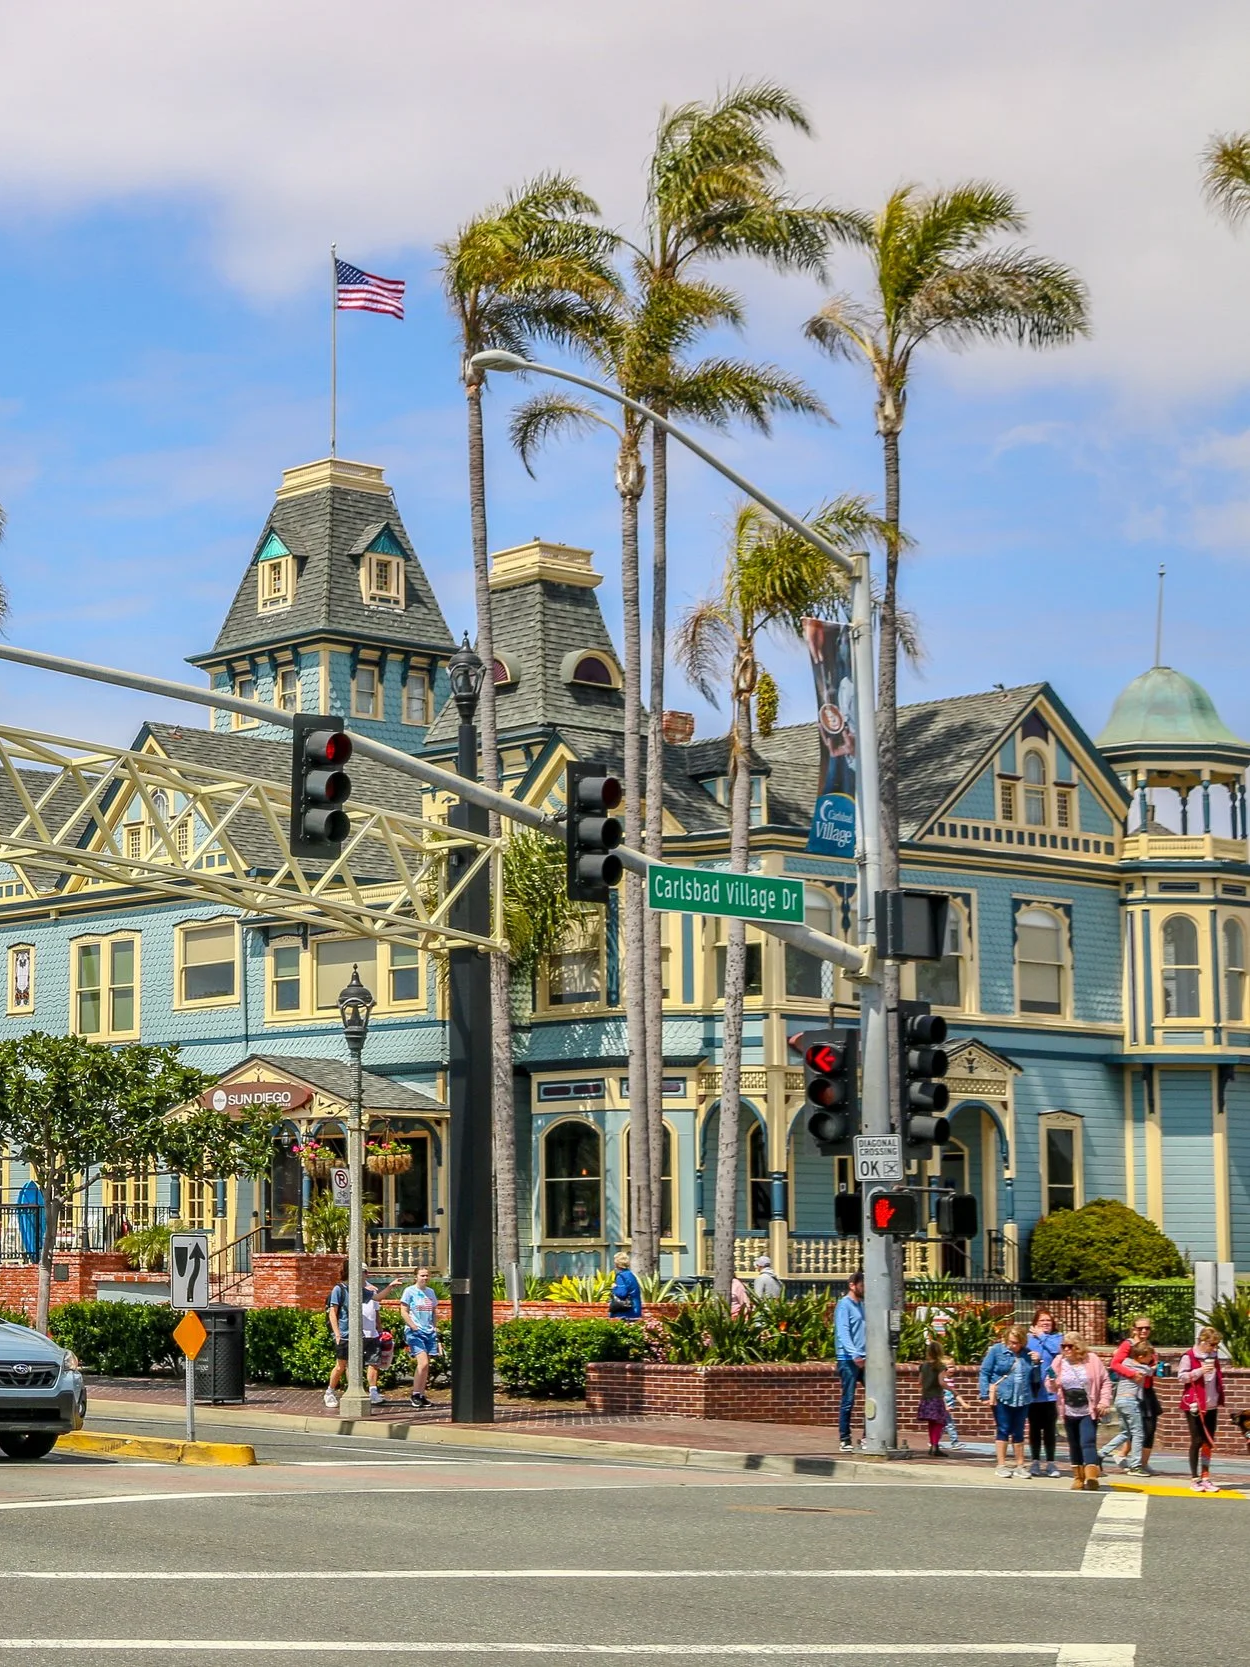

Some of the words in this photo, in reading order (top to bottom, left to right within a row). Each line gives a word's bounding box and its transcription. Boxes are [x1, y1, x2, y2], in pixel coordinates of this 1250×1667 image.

[815, 821, 852, 848] Village
[654, 874, 720, 903] Carlsbad
[726, 881, 776, 914] Village
[782, 888, 798, 911] Dr
[228, 1093, 252, 1106] SUN
[254, 1091, 291, 1104] DIEGO
[858, 1139, 898, 1148] DIAGONAL
[859, 1147, 898, 1156] CROSSING
[860, 1160, 880, 1177] OK
